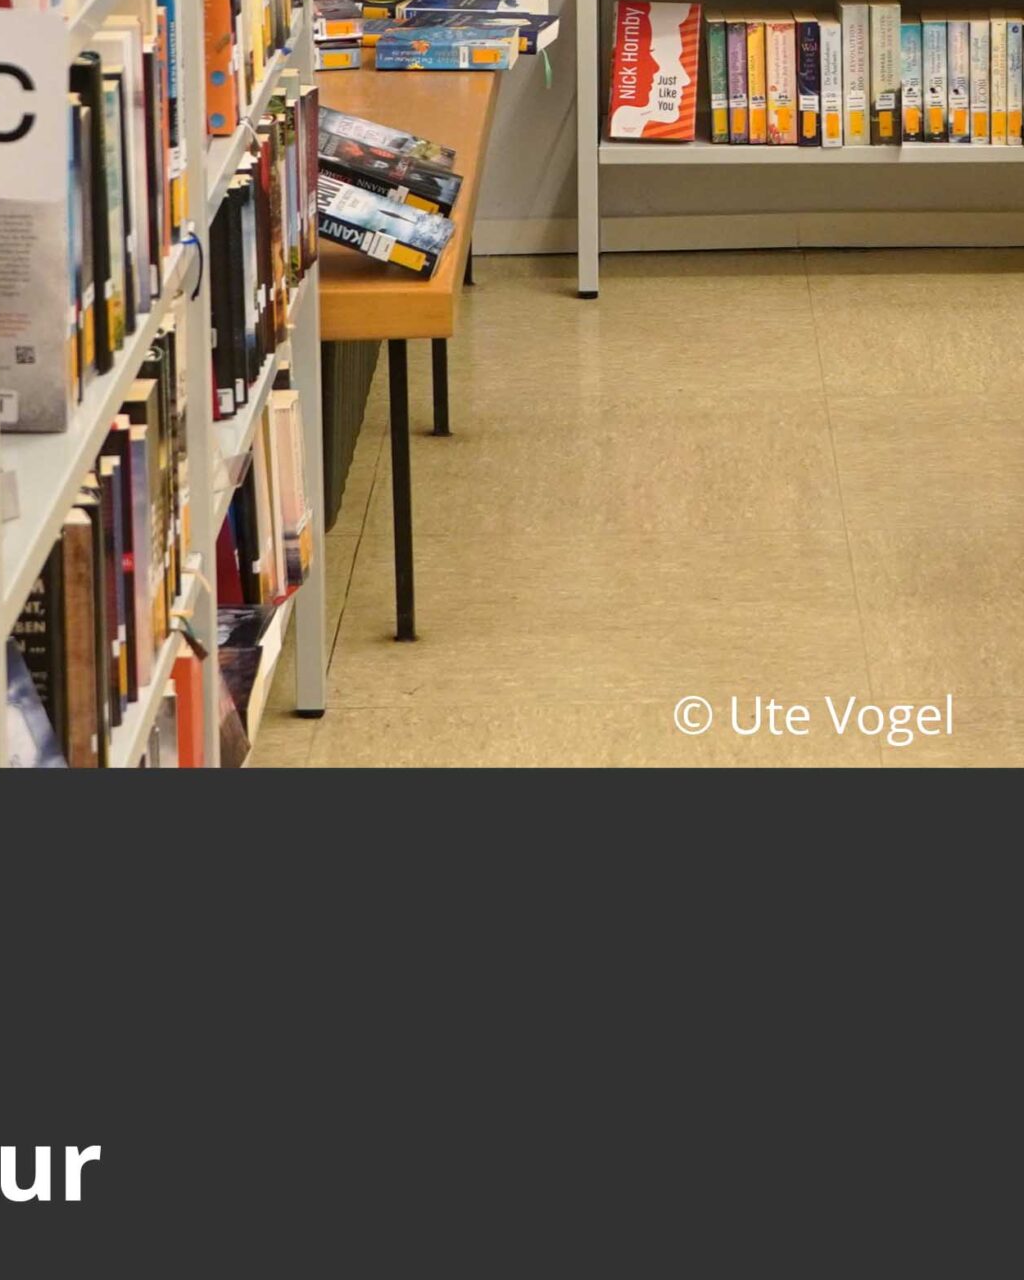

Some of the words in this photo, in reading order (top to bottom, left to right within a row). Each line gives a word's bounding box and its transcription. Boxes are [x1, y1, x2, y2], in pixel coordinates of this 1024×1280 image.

[621, 7, 645, 62] Hornby
[618, 66, 638, 99] Nick
[658, 76, 677, 85] Just
[659, 88, 677, 98] Like
[658, 101, 674, 111] You
